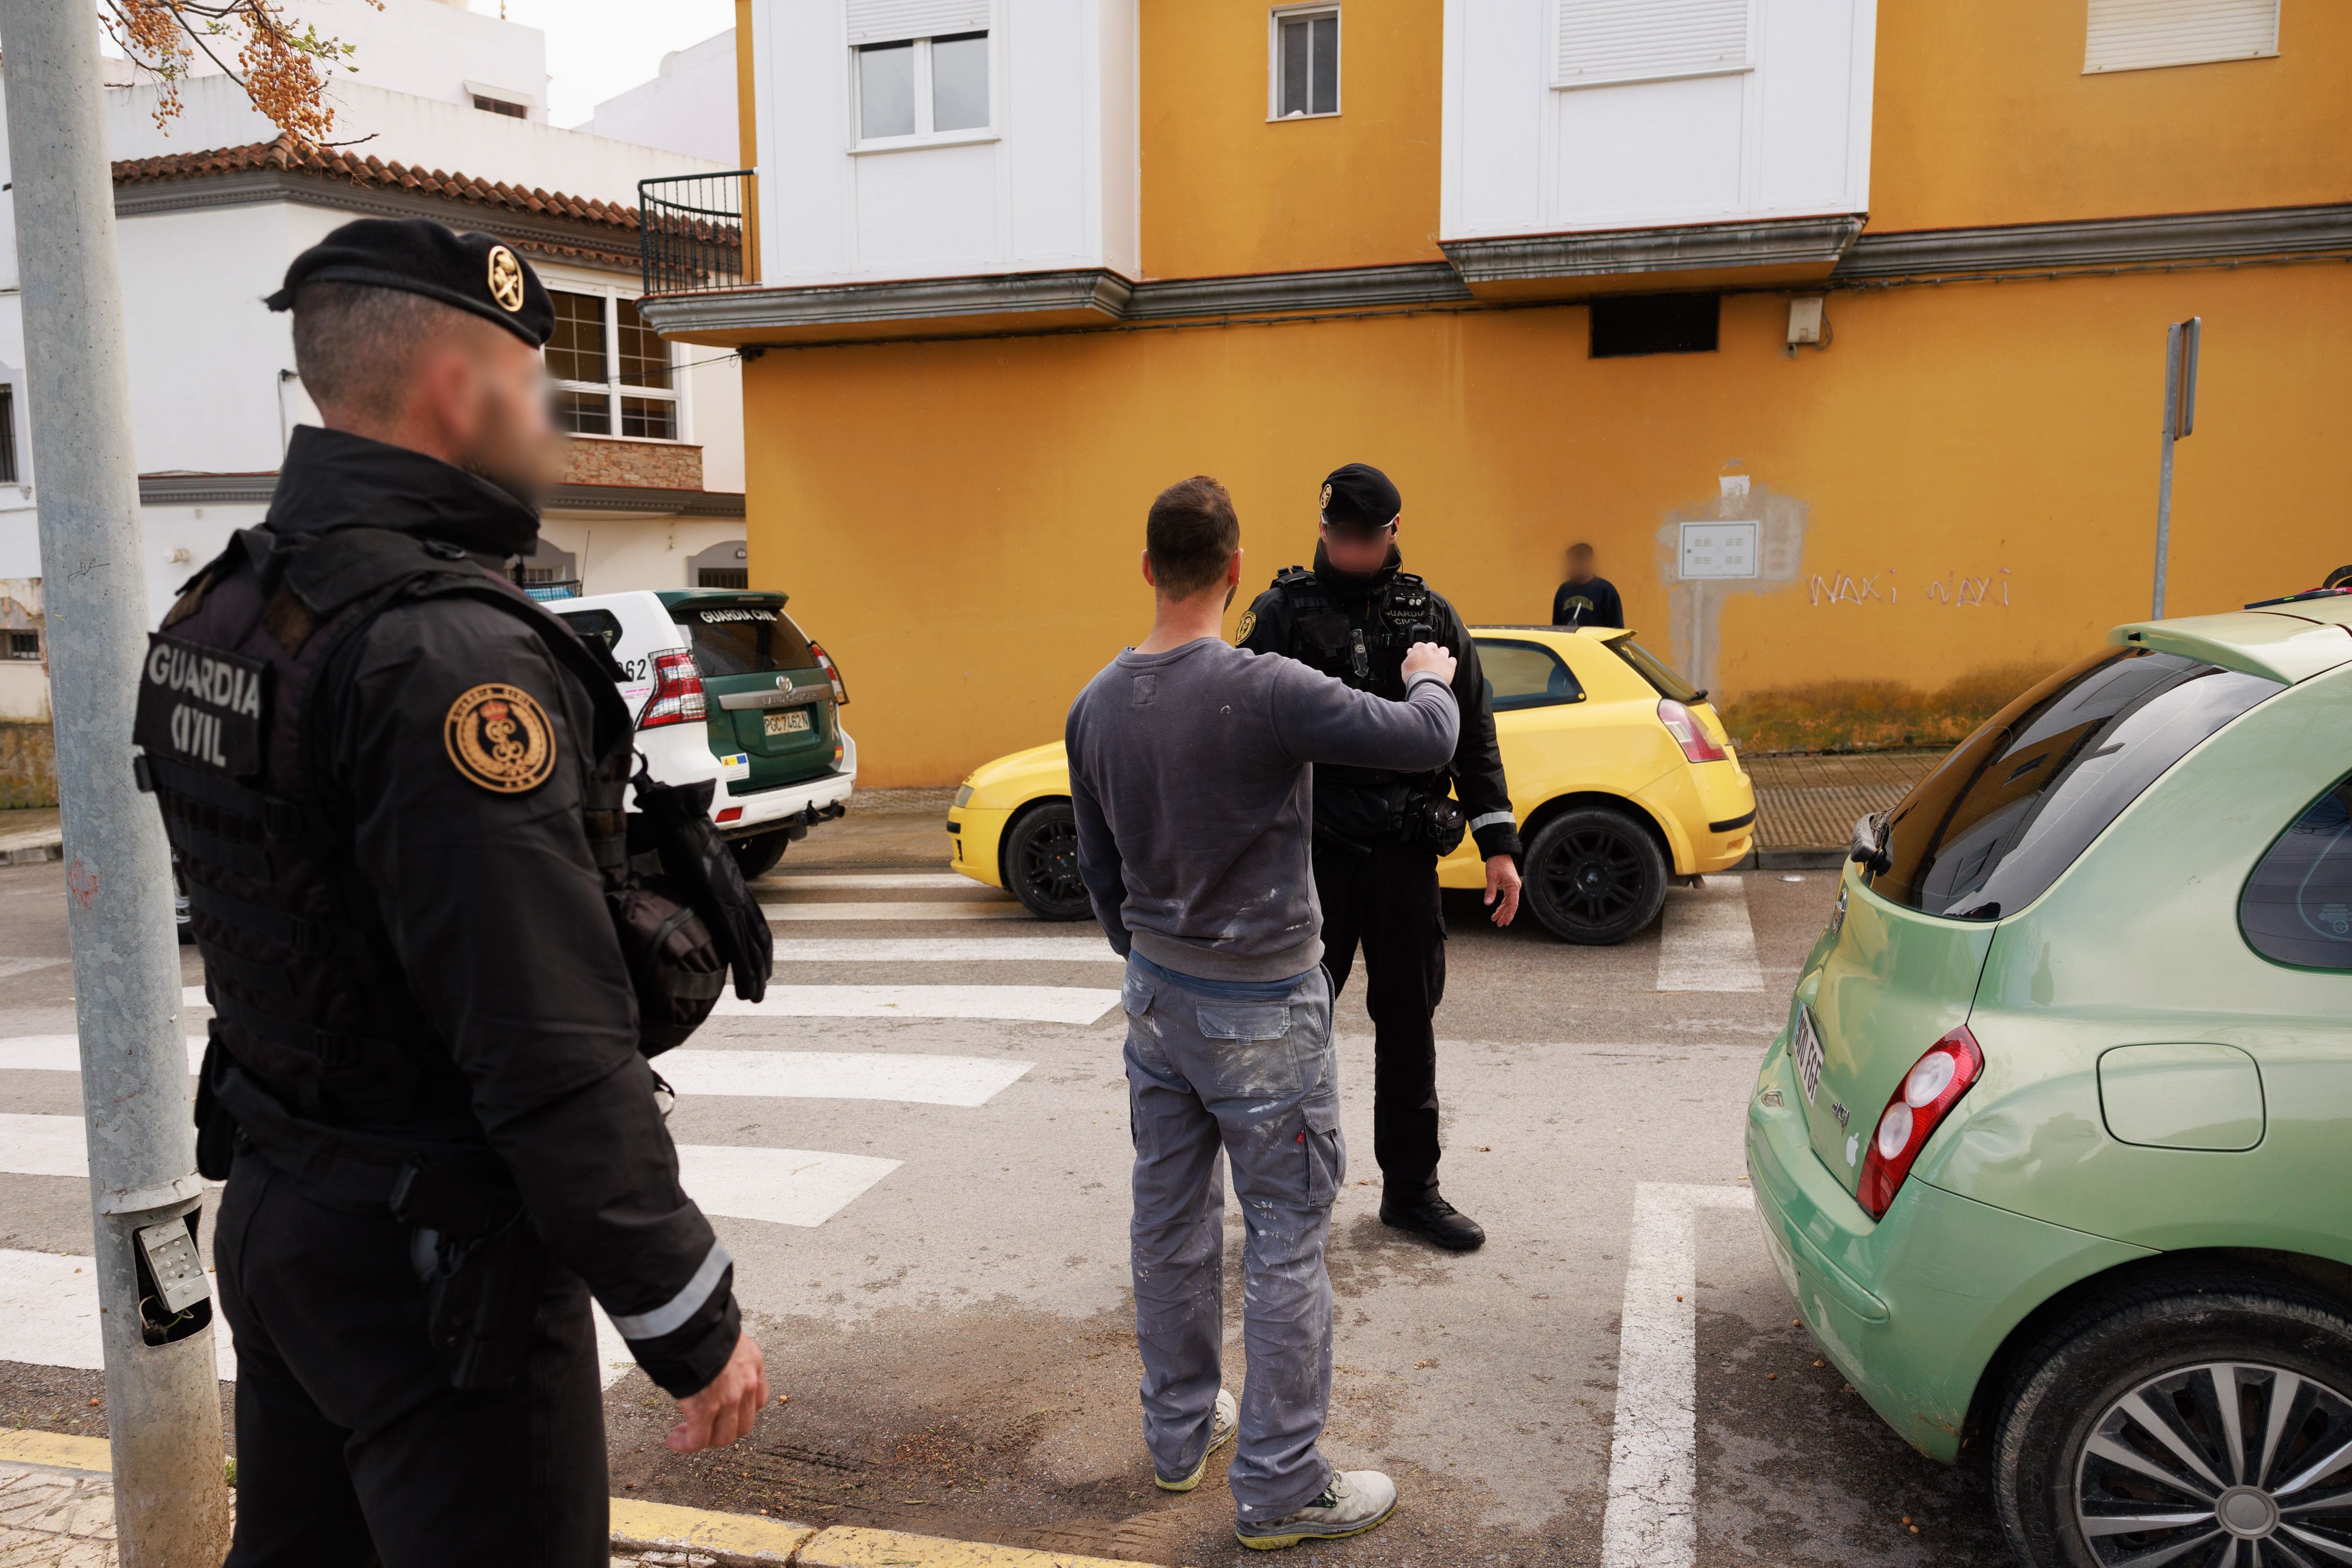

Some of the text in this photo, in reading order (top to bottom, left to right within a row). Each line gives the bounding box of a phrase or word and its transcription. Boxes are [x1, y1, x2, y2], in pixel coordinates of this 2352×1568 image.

[700, 609, 778, 624] GUARDIA CIVIL
[148, 643, 260, 720] GUARDIA
[171, 703, 226, 768] CIVIL
[1803, 1040, 1822, 1101] FGF
